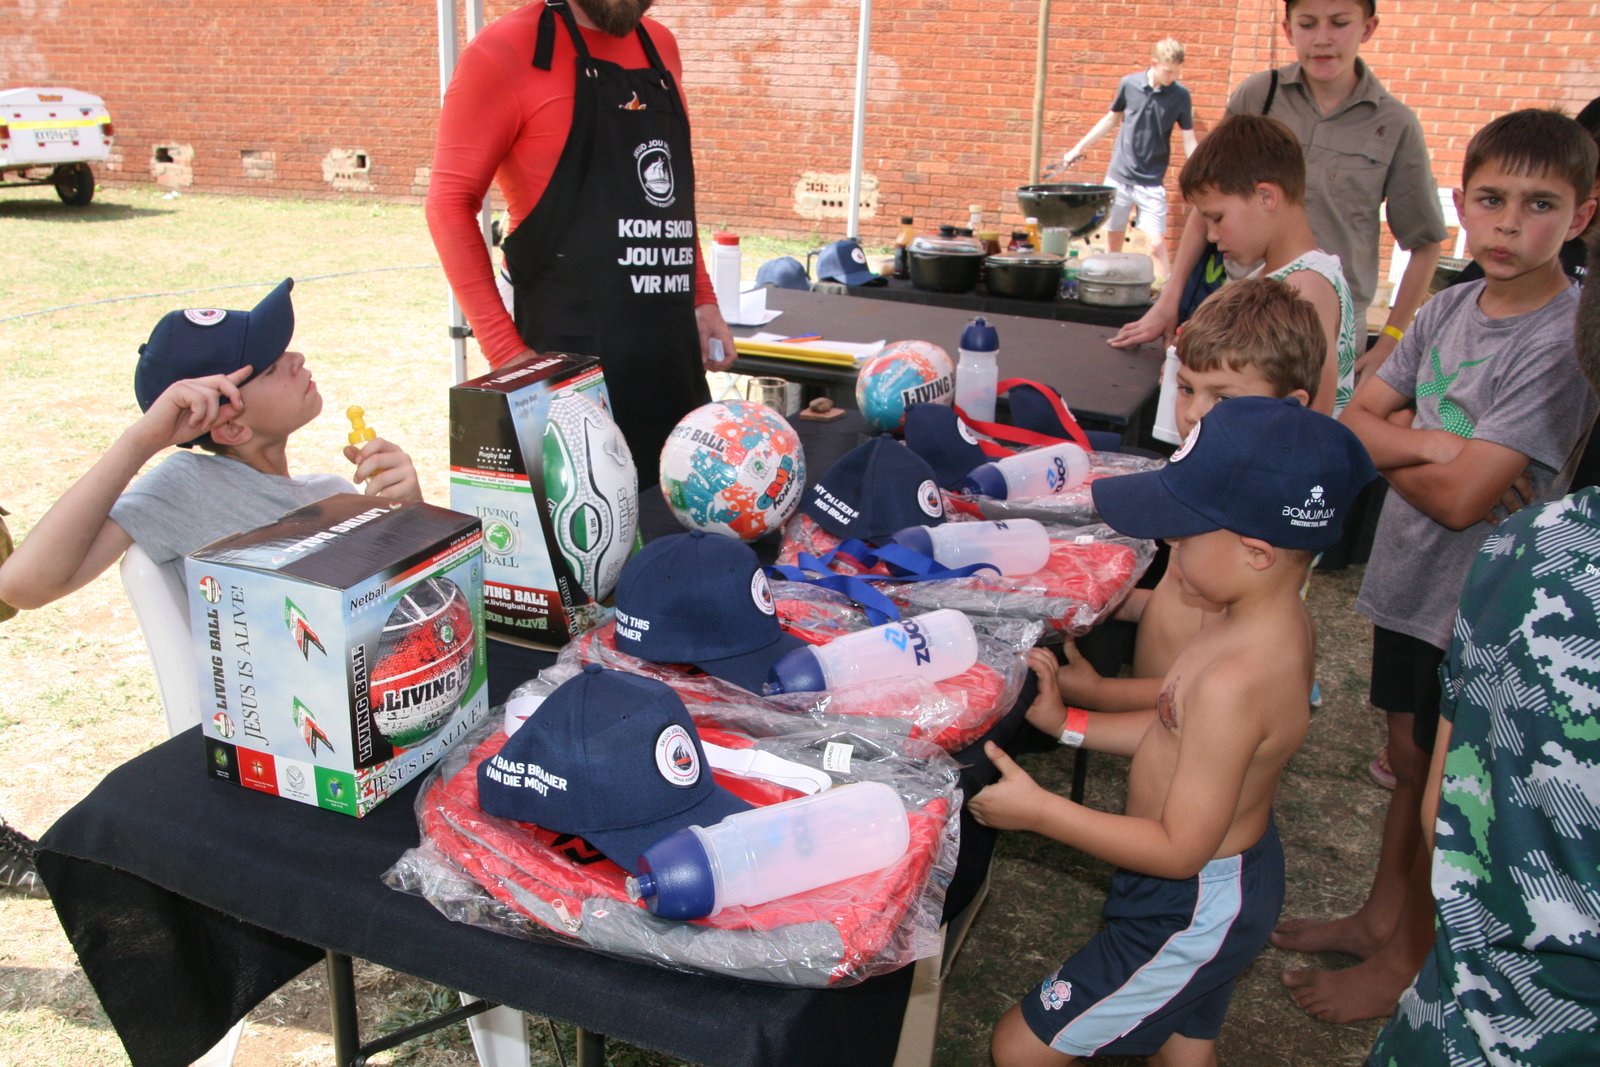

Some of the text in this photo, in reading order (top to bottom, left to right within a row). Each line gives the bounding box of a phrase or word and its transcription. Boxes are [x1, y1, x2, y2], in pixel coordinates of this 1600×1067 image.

[618, 218, 693, 239] KOM SKUD
[617, 247, 693, 266] JOU VLEIS
[630, 274, 661, 294] VIR
[903, 376, 950, 406] LIVING
[691, 428, 725, 453] BALL
[478, 451, 498, 460] Rugby
[476, 506, 519, 527] LIVING
[283, 508, 391, 554] LIVING BALL
[484, 551, 519, 568] BALL
[350, 582, 387, 611] Netball
[484, 585, 548, 607] VING BALL
[484, 600, 549, 614] w.livingball.co.za
[630, 616, 650, 631] THIS
[208, 608, 229, 711] LIVING BALL
[231, 585, 270, 746] JESUS IS ALIVE!
[355, 644, 373, 763] LIVING BALL
[384, 671, 457, 712] LIVING
[371, 761, 418, 803] JESUS
[420, 749, 435, 765] IS
[438, 700, 483, 752] ALIVE!
[486, 764, 549, 797] VAN DIE MOOT
[497, 756, 525, 774] BAAS
[527, 763, 568, 791] BRAAIER
